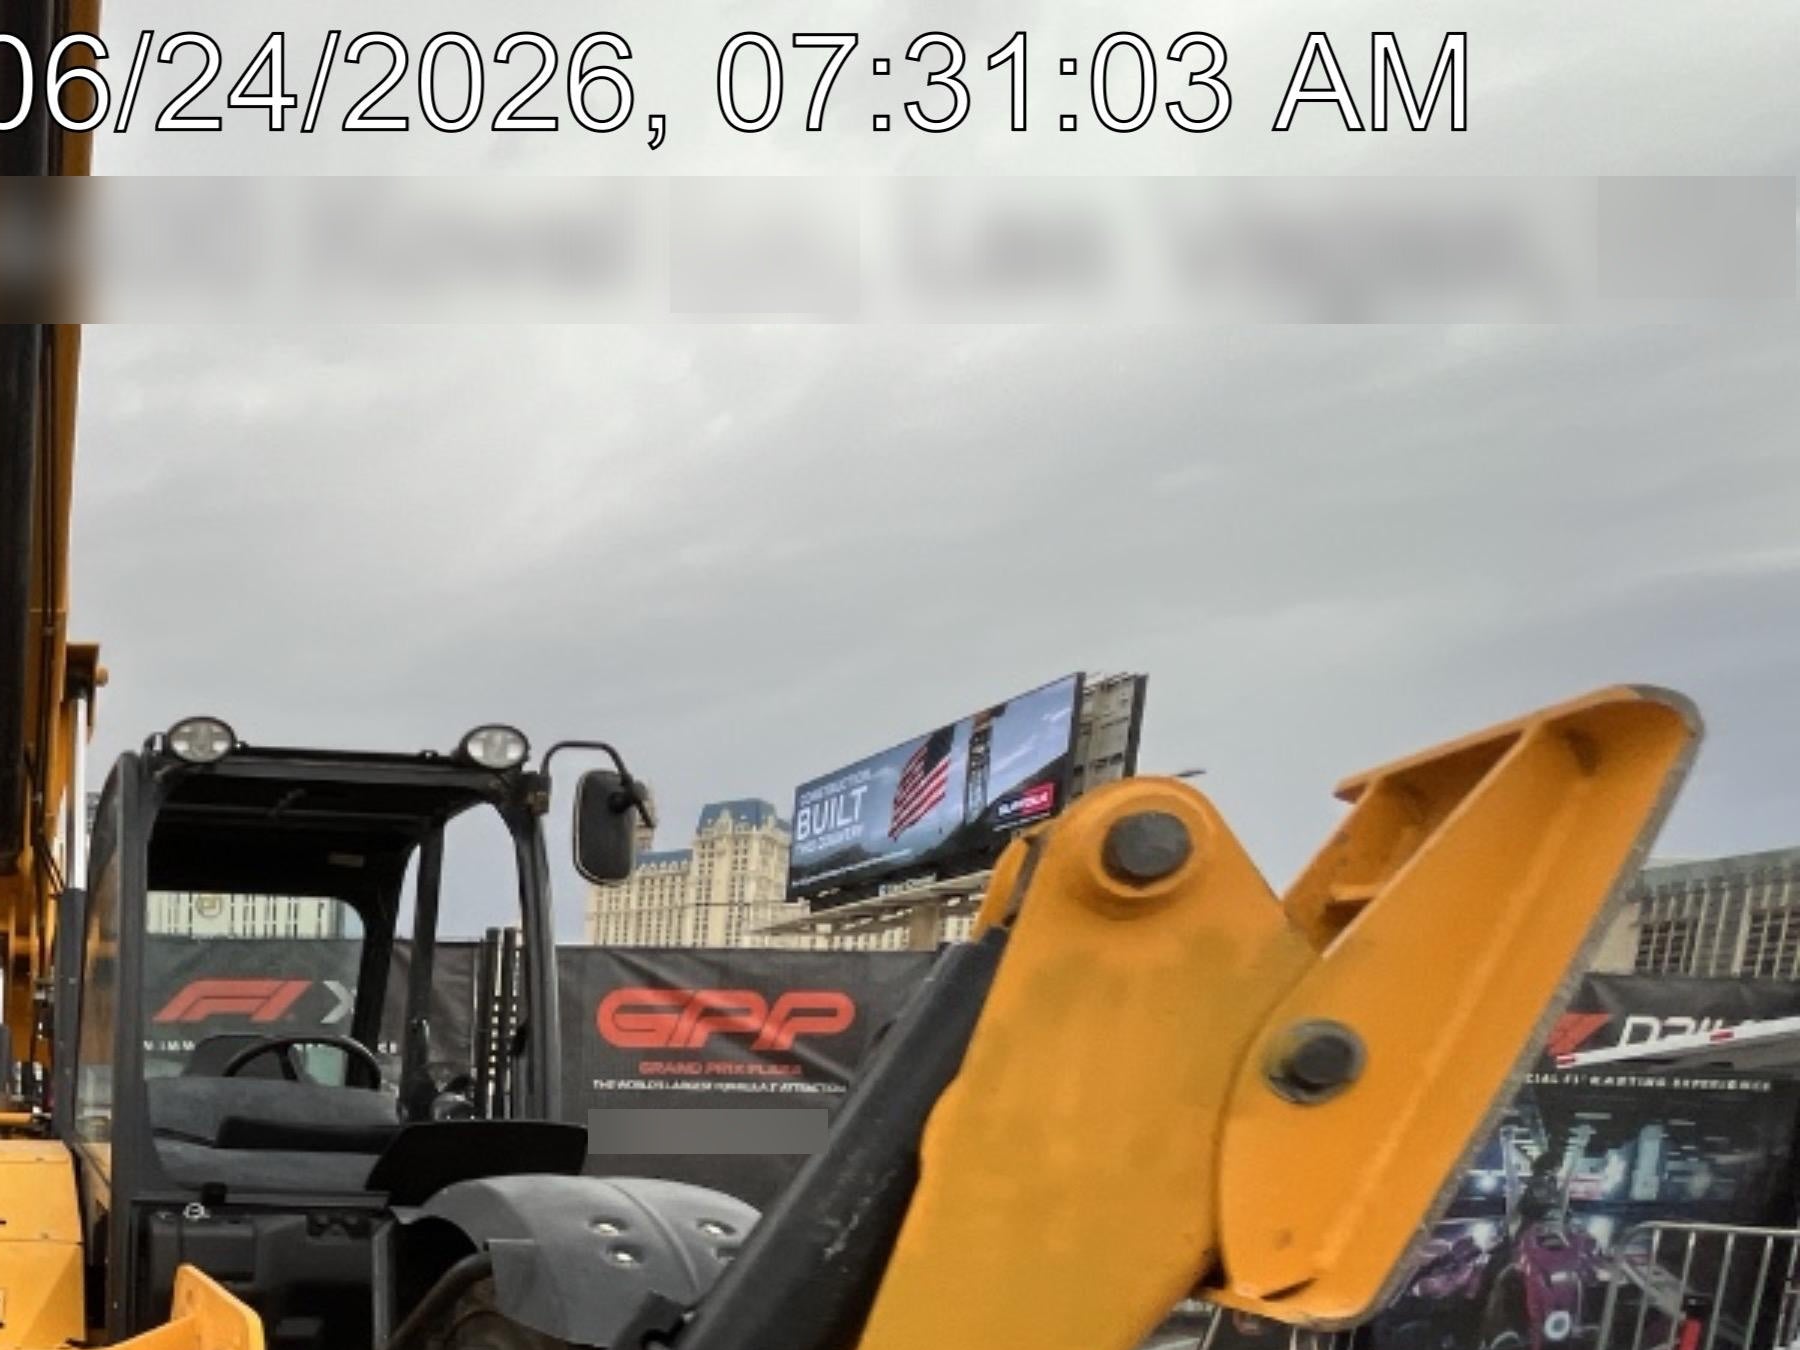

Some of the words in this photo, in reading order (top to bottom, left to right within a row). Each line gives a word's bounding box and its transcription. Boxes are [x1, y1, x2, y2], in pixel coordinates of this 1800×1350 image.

[797, 785, 869, 842] BUILT
[595, 985, 857, 1050] GPP
[638, 1061, 702, 1076] GRAND
